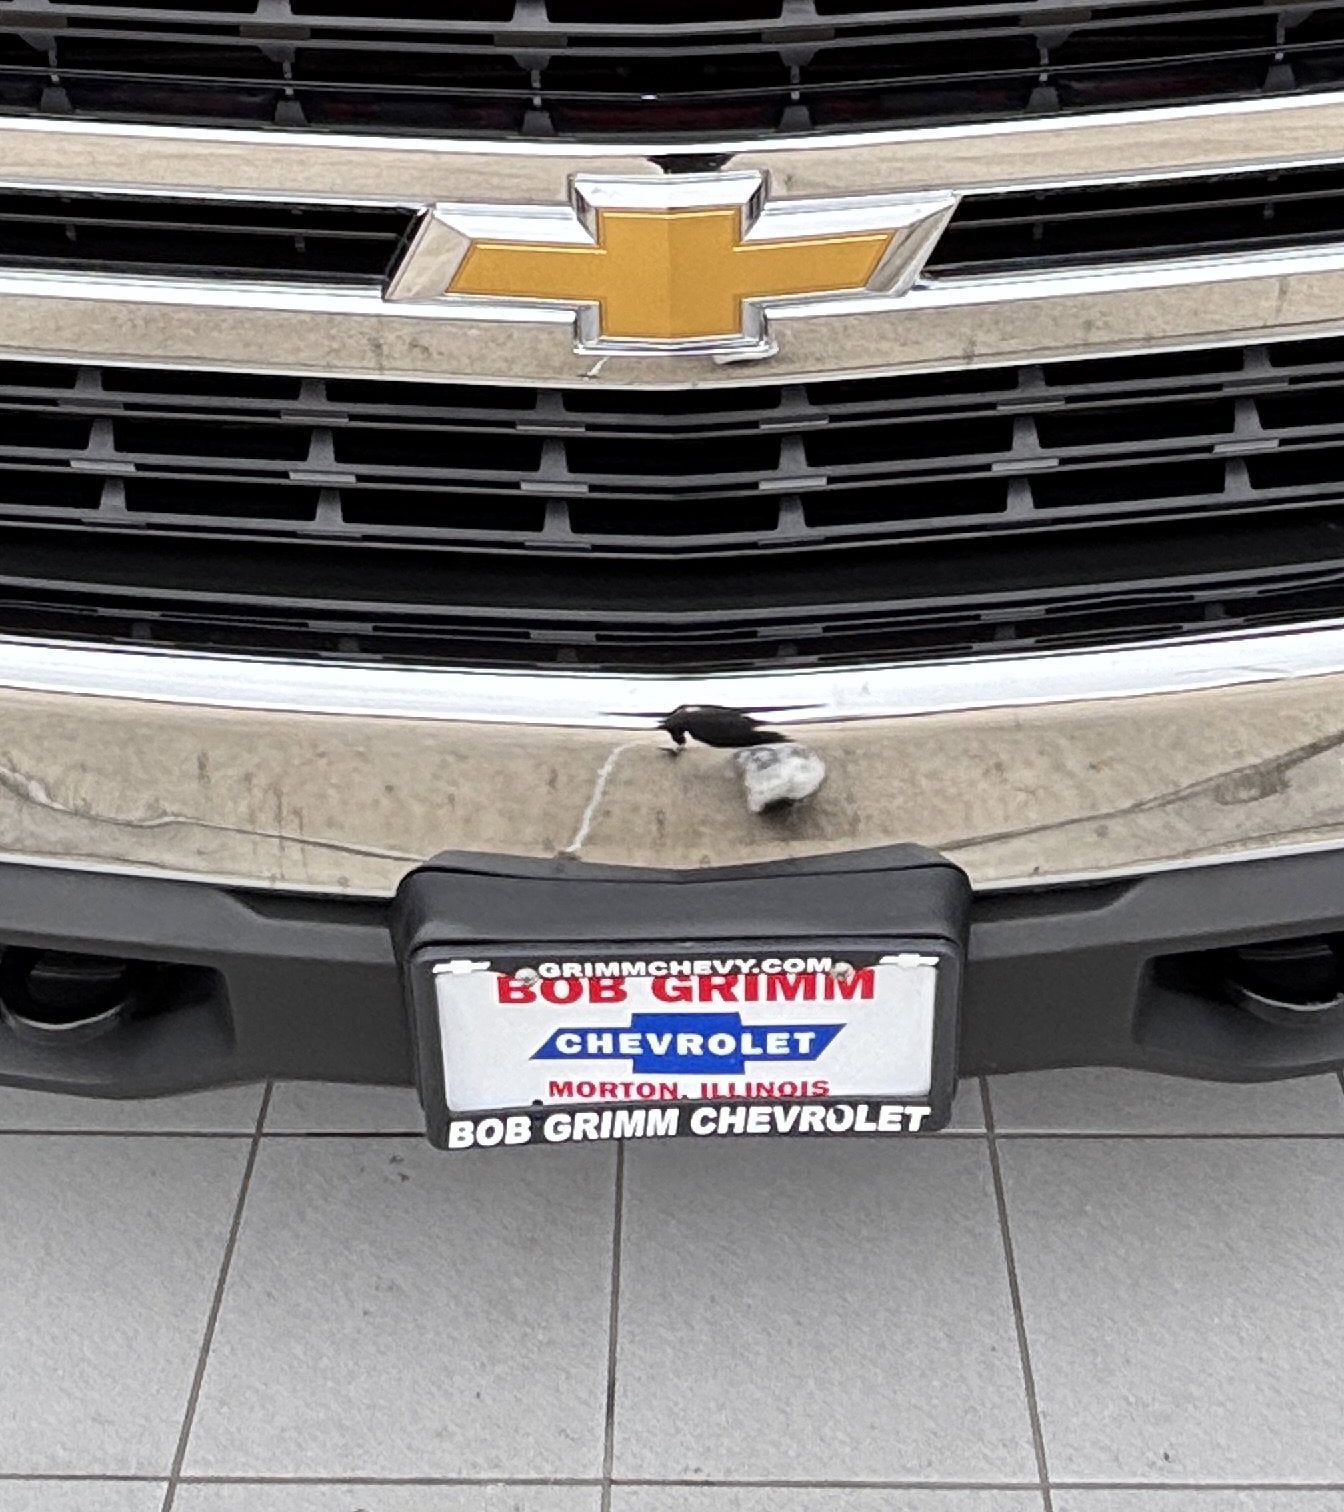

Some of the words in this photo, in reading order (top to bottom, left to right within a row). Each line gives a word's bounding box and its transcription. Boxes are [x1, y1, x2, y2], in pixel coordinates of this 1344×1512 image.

[538, 958, 832, 978] GRIMMCHEVY.COM
[497, 975, 628, 1004] BOB
[651, 968, 876, 1003] GRIMM
[555, 1031, 816, 1056] CHEVROLET
[700, 1080, 830, 1100] ILLINOIS
[448, 1116, 532, 1149] BOB
[544, 1108, 680, 1142] GRIMM
[690, 1104, 932, 1136] CHEVROLET
